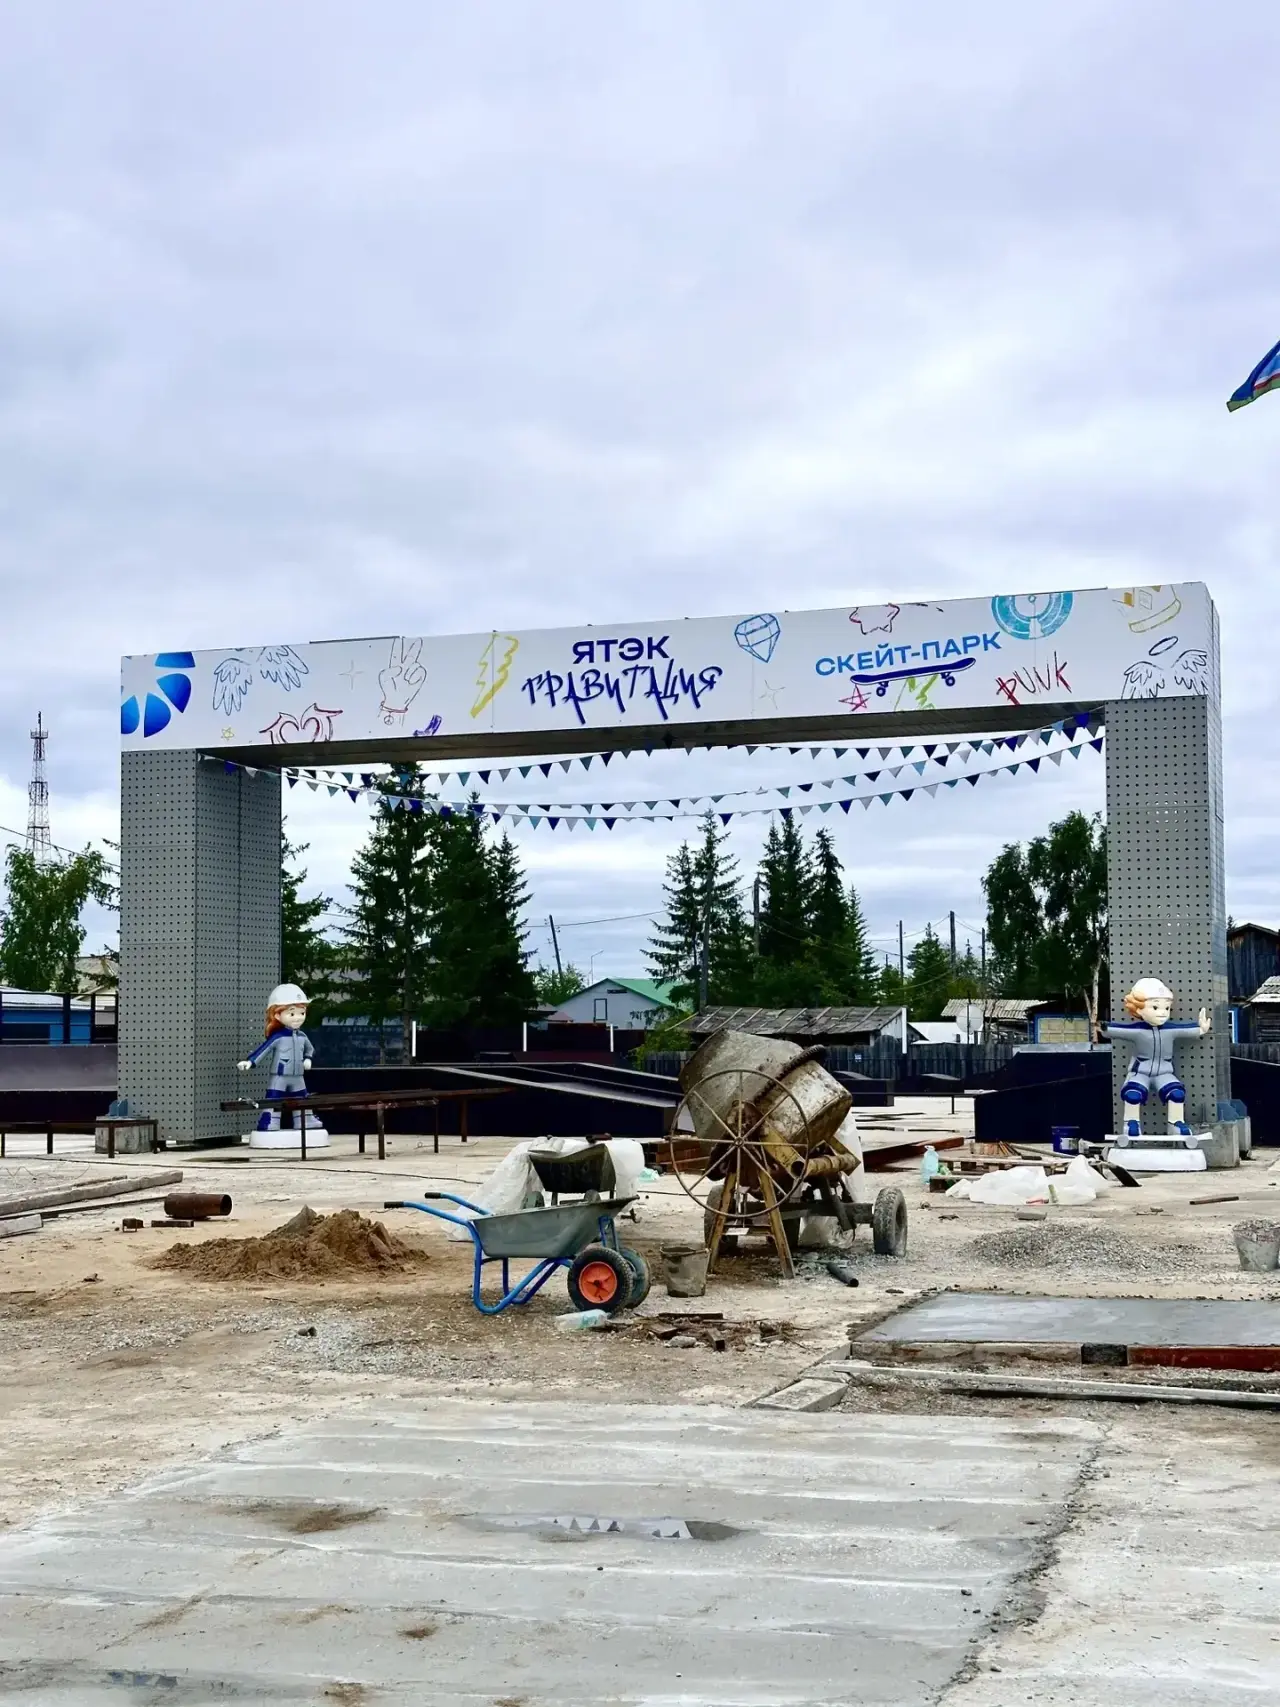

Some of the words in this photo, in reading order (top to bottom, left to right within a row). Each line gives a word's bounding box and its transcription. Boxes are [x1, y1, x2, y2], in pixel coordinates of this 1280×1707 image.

[572, 636, 669, 664] ЯТЭК
[815, 632, 1002, 676] СКЕЙТ-ПАРК
[522, 659, 723, 724] ГРАВИТАЦИЯ
